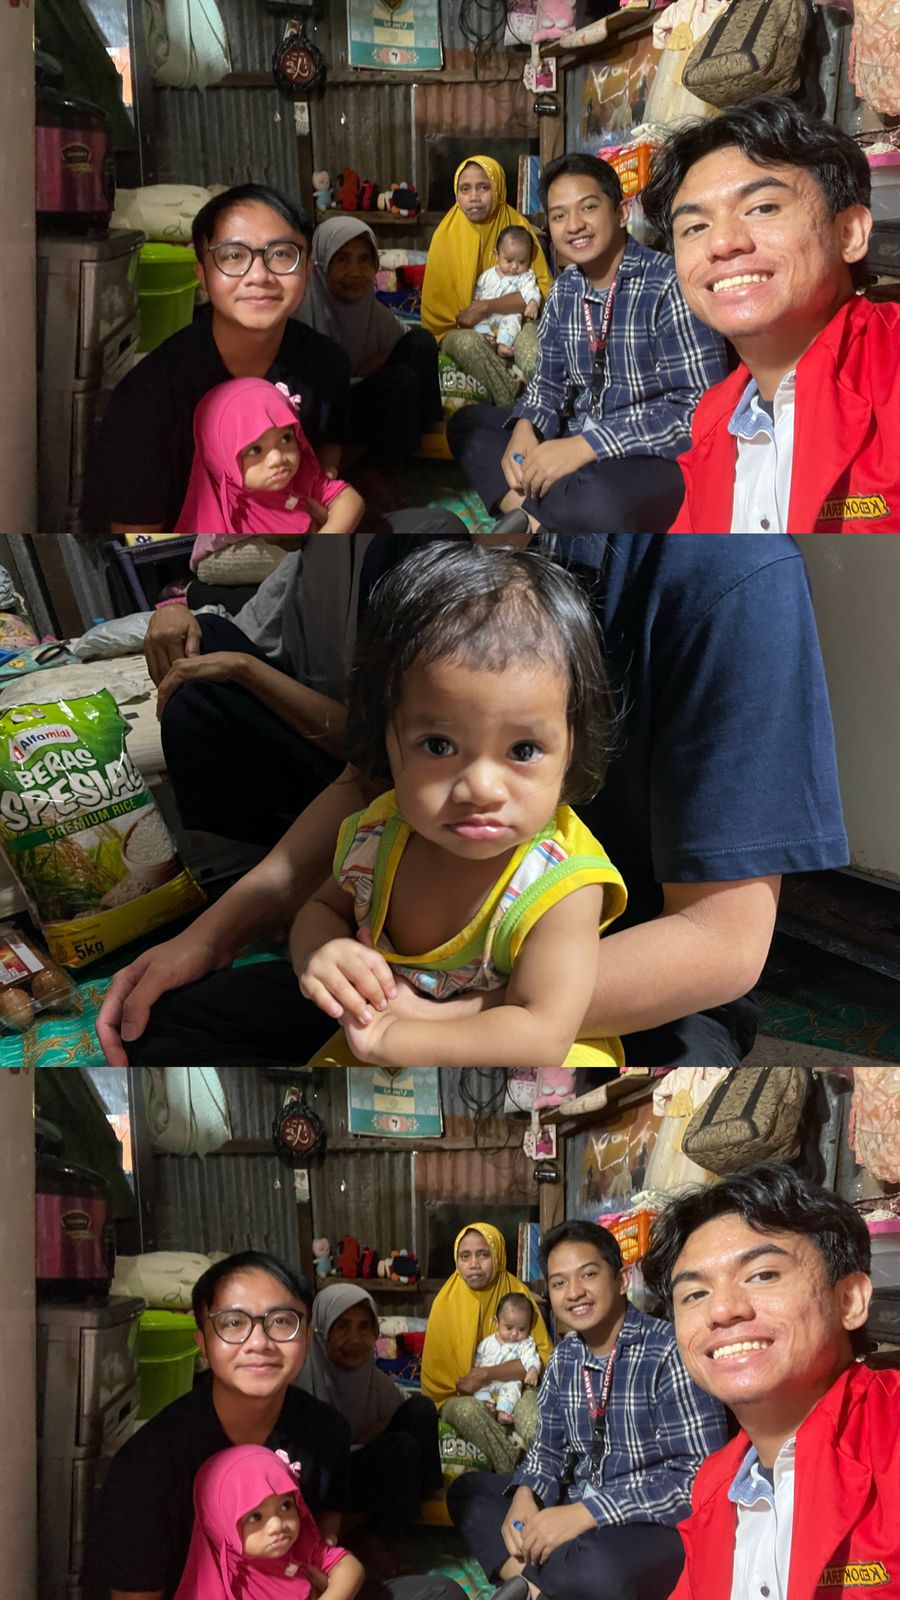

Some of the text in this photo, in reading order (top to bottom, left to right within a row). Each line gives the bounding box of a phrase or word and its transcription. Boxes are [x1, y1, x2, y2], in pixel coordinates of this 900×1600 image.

[20, 728, 71, 751] Alfamidi
[15, 748, 97, 790] BERAS
[0, 752, 143, 833] SPESIAL
[48, 799, 137, 839] PREMIUM RICE
[74, 940, 104, 960] 5kg
